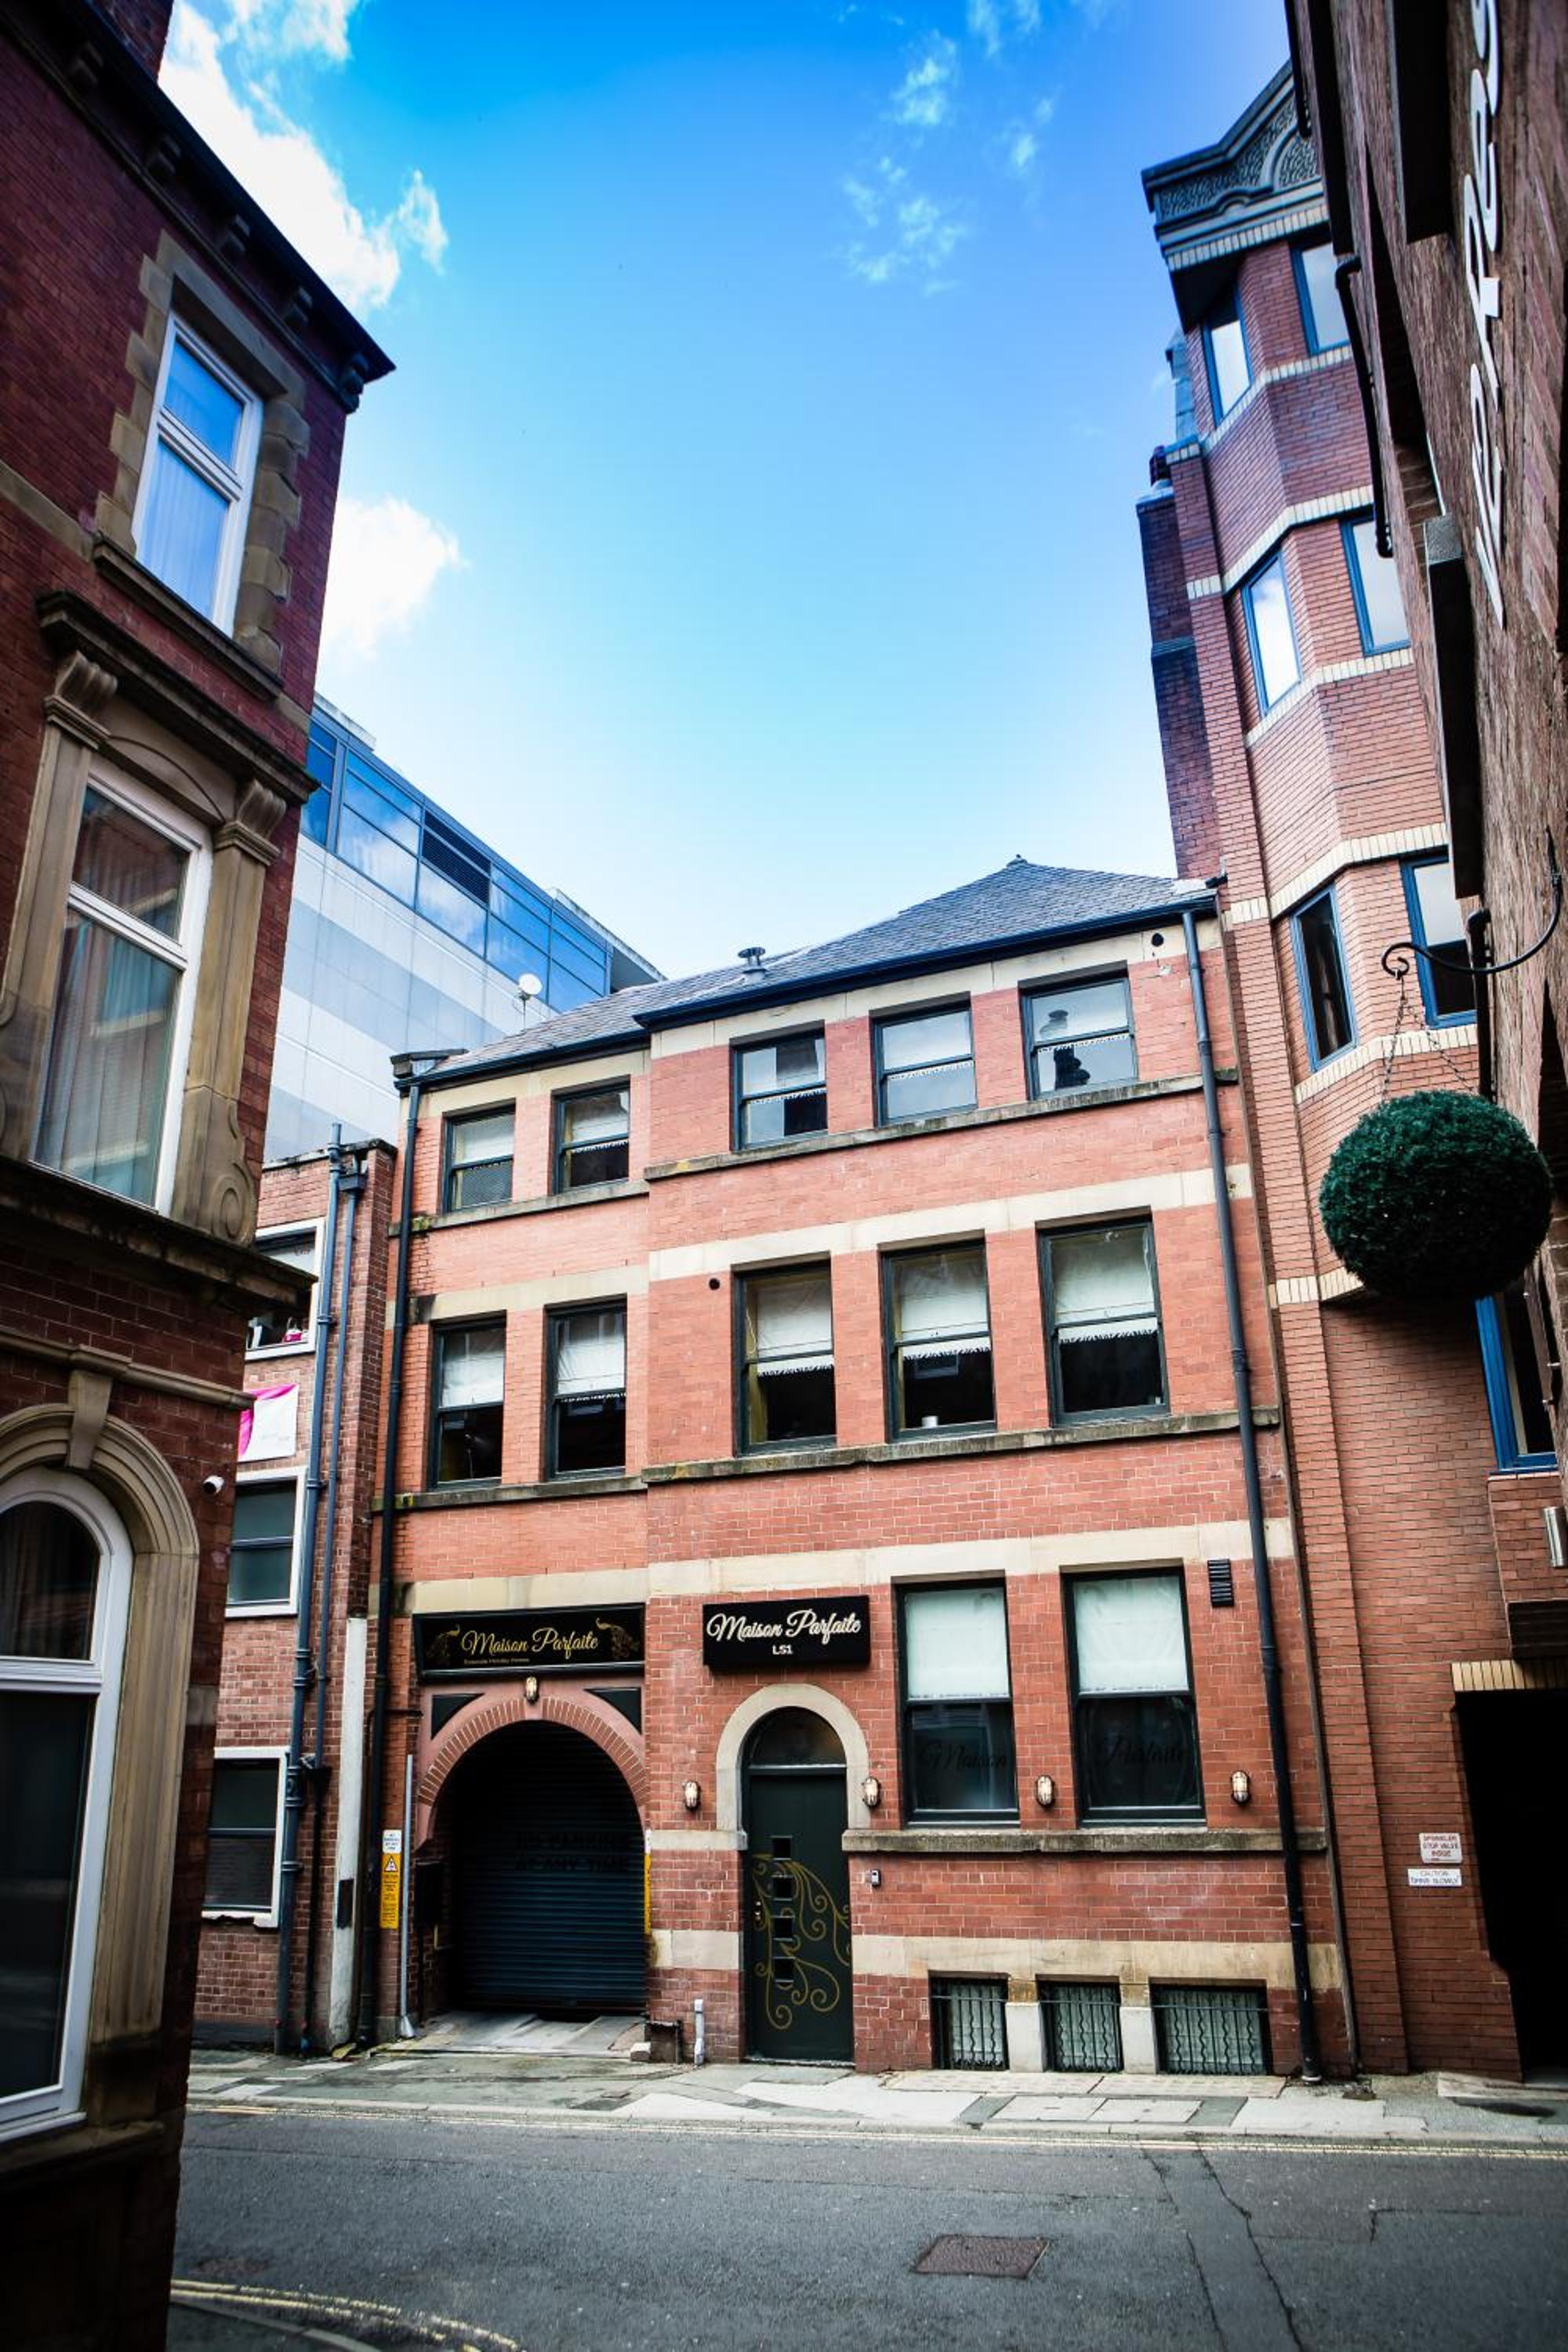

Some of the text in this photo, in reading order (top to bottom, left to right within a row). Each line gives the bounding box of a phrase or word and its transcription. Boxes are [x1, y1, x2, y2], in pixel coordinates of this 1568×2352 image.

[706, 1609, 861, 1644] Maison Parfaite
[461, 1628, 600, 1659] Maison Parfaite
[772, 1645, 793, 1655] LS1
